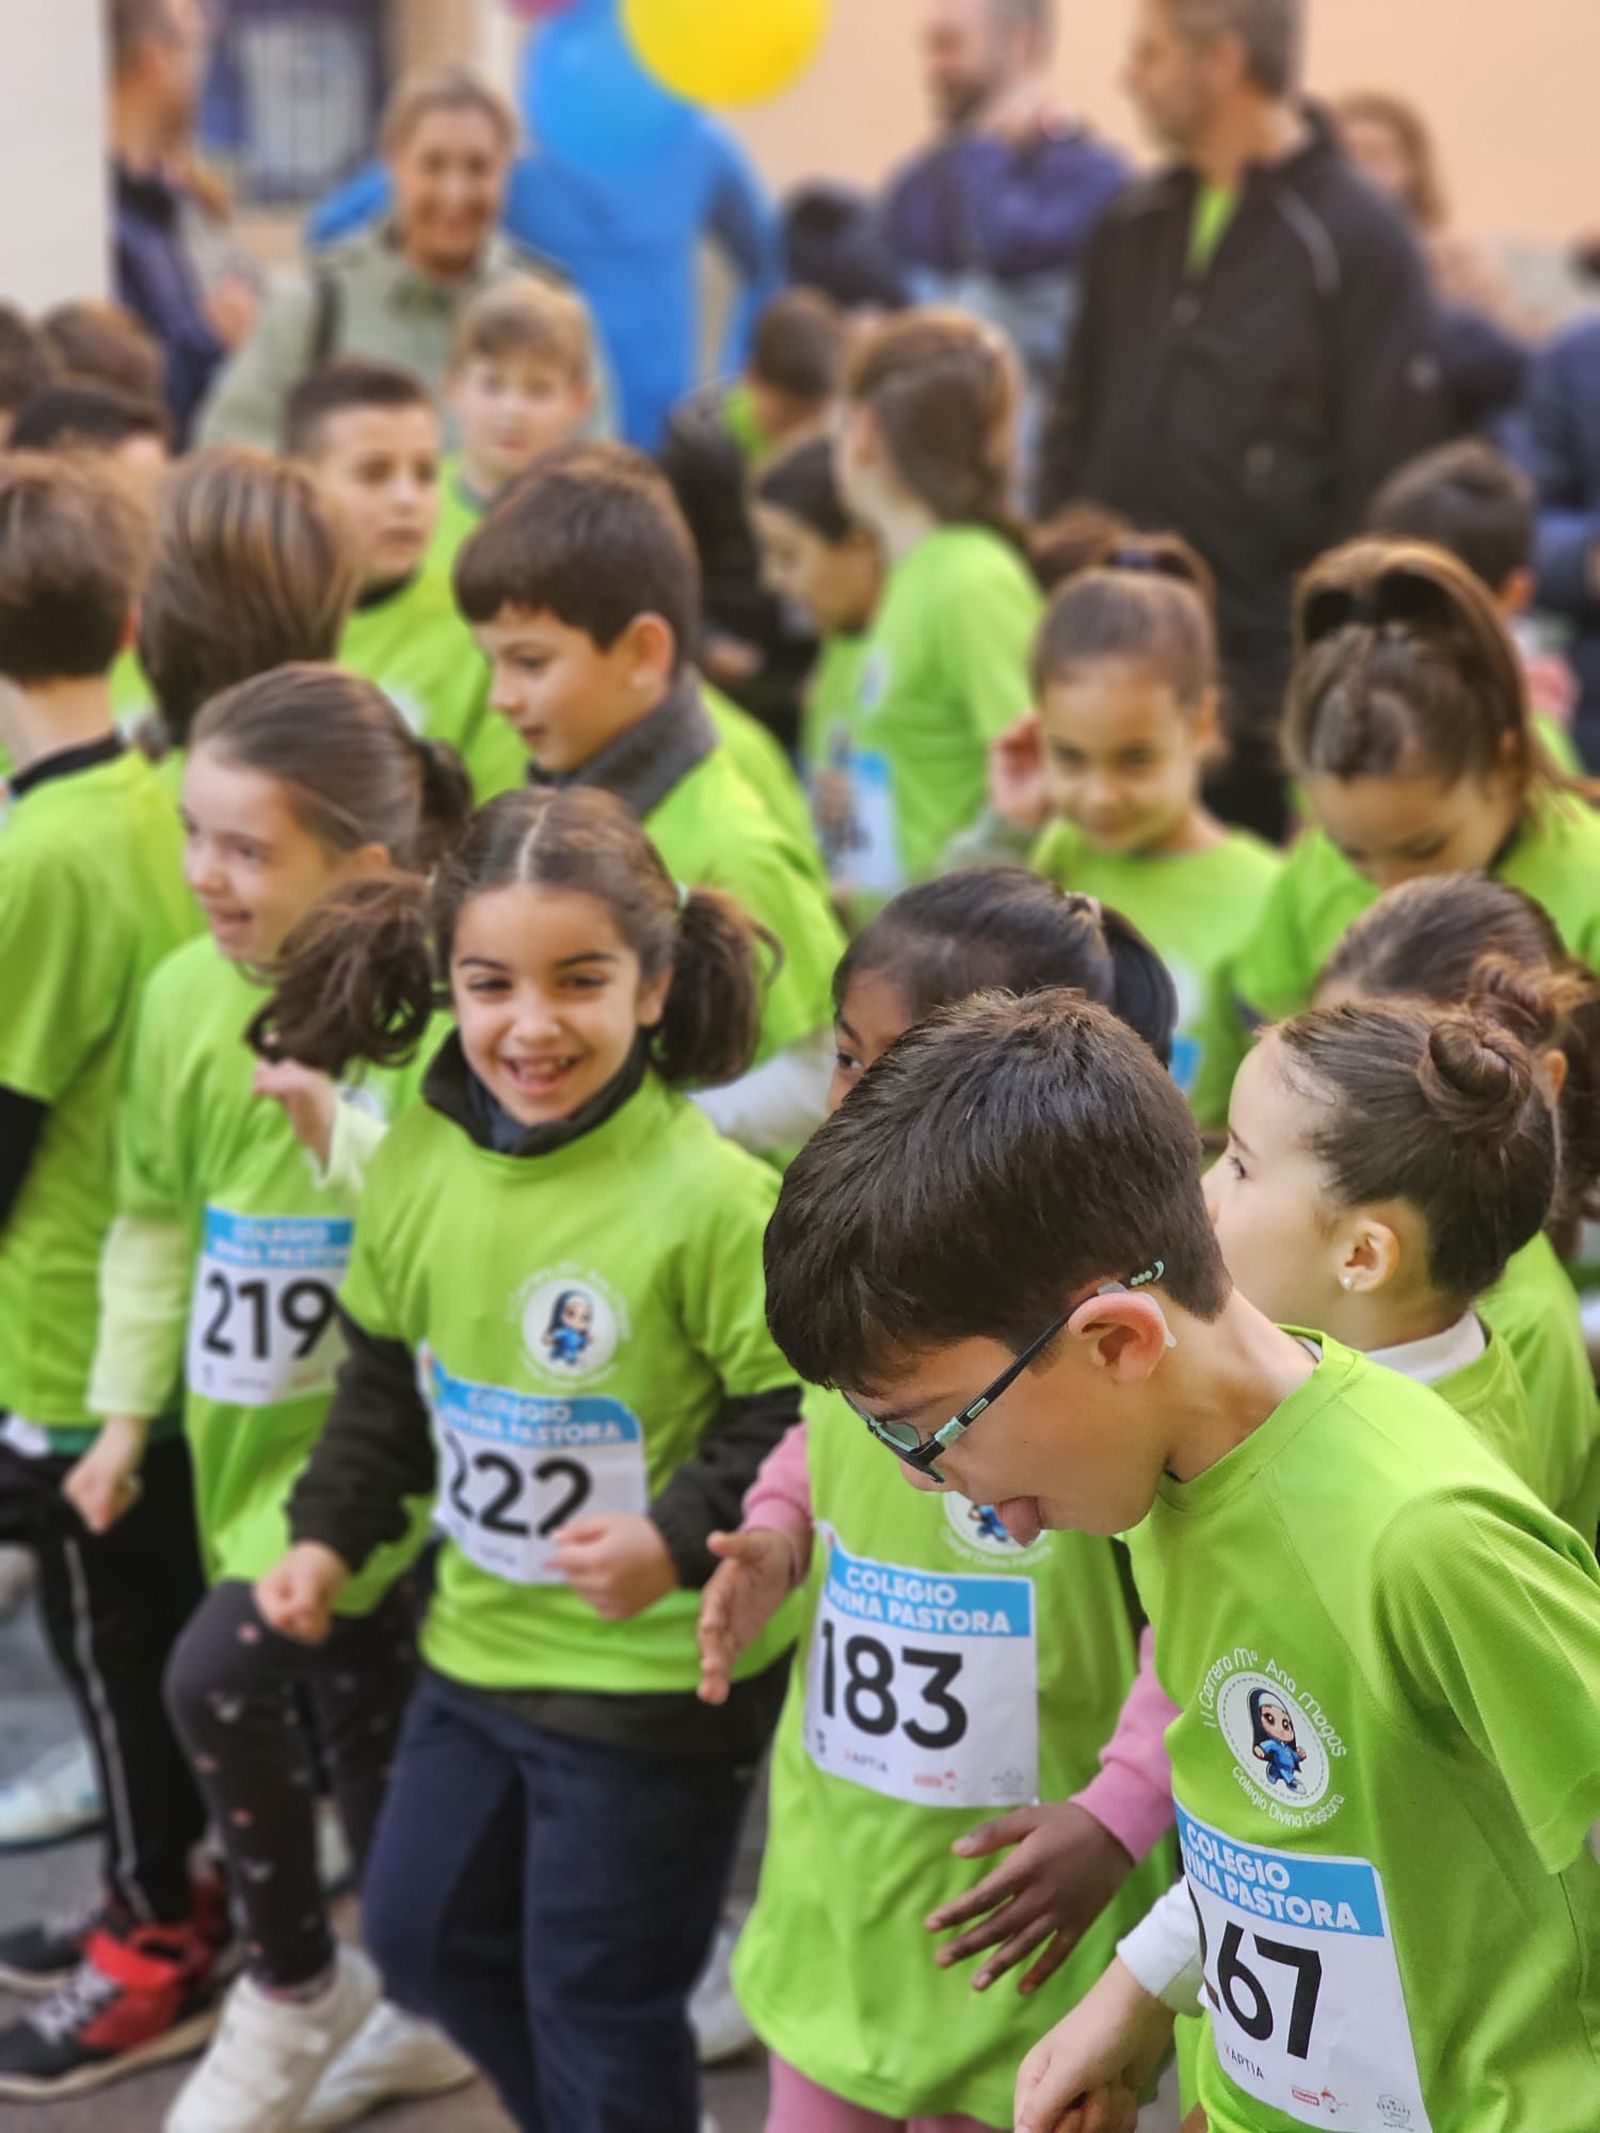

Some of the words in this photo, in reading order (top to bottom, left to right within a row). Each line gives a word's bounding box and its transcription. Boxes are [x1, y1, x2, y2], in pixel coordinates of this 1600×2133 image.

[203, 1271, 336, 1359] 219
[846, 1565, 957, 1607] COLEGIO
[888, 1599, 1011, 1634] PASTORA
[822, 1619, 968, 1751] 183
[1265, 1658, 1297, 1694] Ana
[1232, 1766, 1268, 1810] Colegio
[1268, 1802, 1302, 1829] Divina
[1186, 1823, 1290, 1890] COLEGIO
[1224, 1874, 1361, 1931] PASTORA
